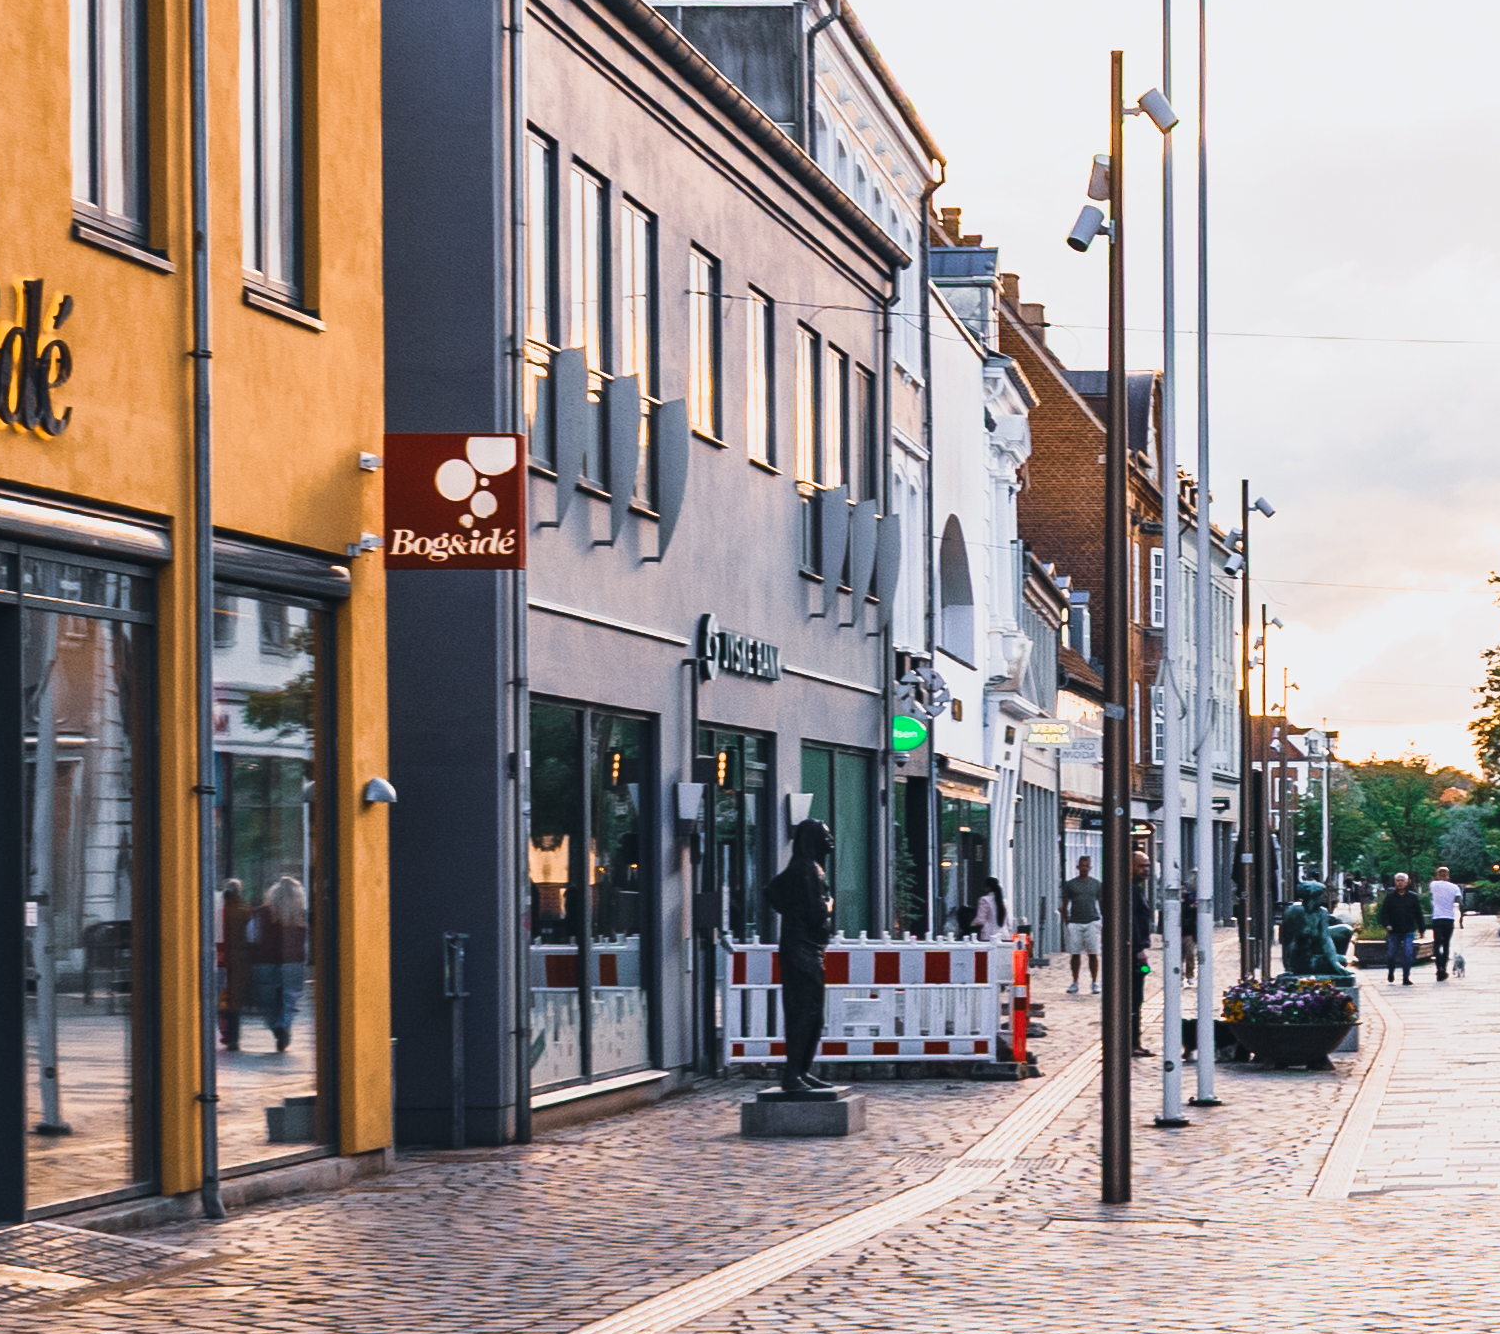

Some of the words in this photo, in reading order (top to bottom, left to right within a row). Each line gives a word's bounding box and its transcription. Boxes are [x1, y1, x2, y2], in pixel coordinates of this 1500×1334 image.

[389, 528, 516, 562] Bog&idé
[1030, 723, 1069, 734] VERO
[1027, 733, 1070, 744] MODA
[1071, 742, 1096, 751] ERO
